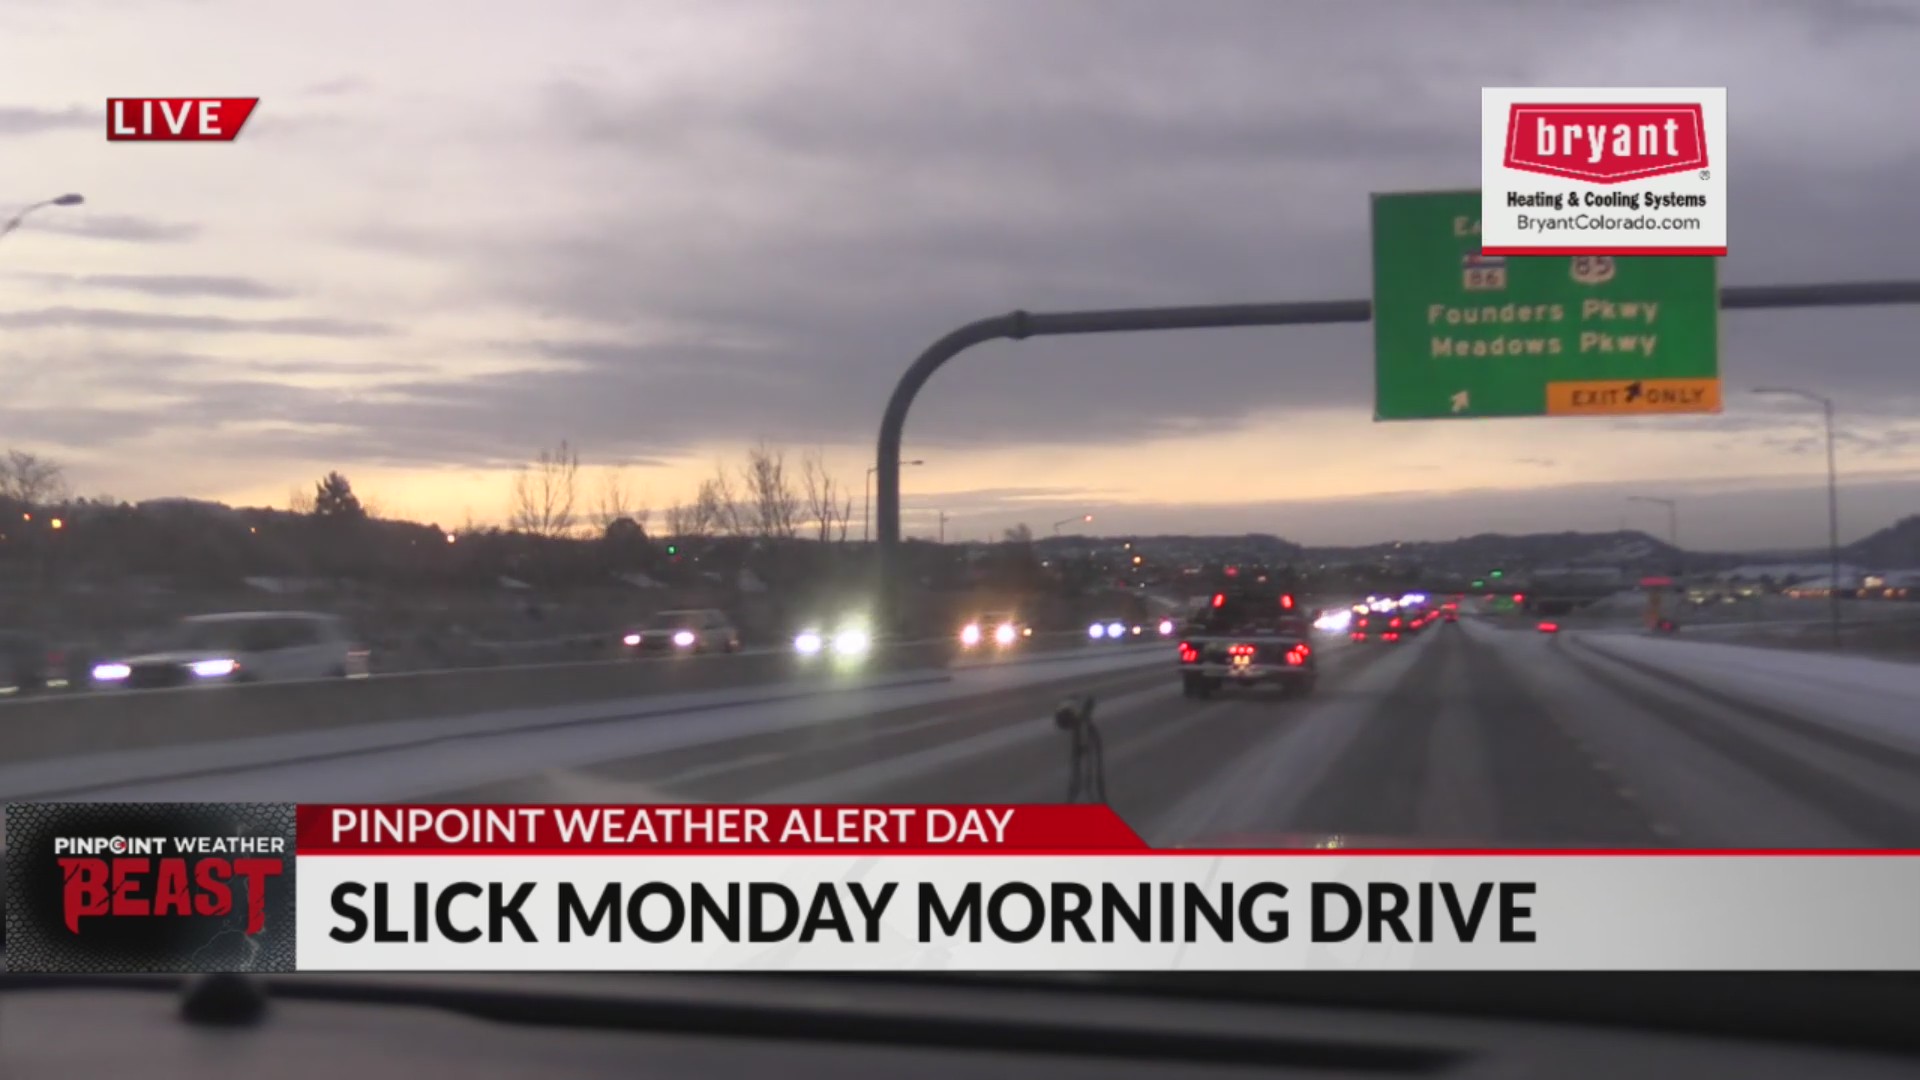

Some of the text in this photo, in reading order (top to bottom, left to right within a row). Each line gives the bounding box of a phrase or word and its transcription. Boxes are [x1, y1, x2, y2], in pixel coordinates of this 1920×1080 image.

[1469, 270, 1499, 286] 86
[1428, 298, 1658, 324] Founders Pkwy
[1430, 331, 1657, 357] Meadows Pkwy
[1571, 387, 1705, 407] EXIT ONLY
